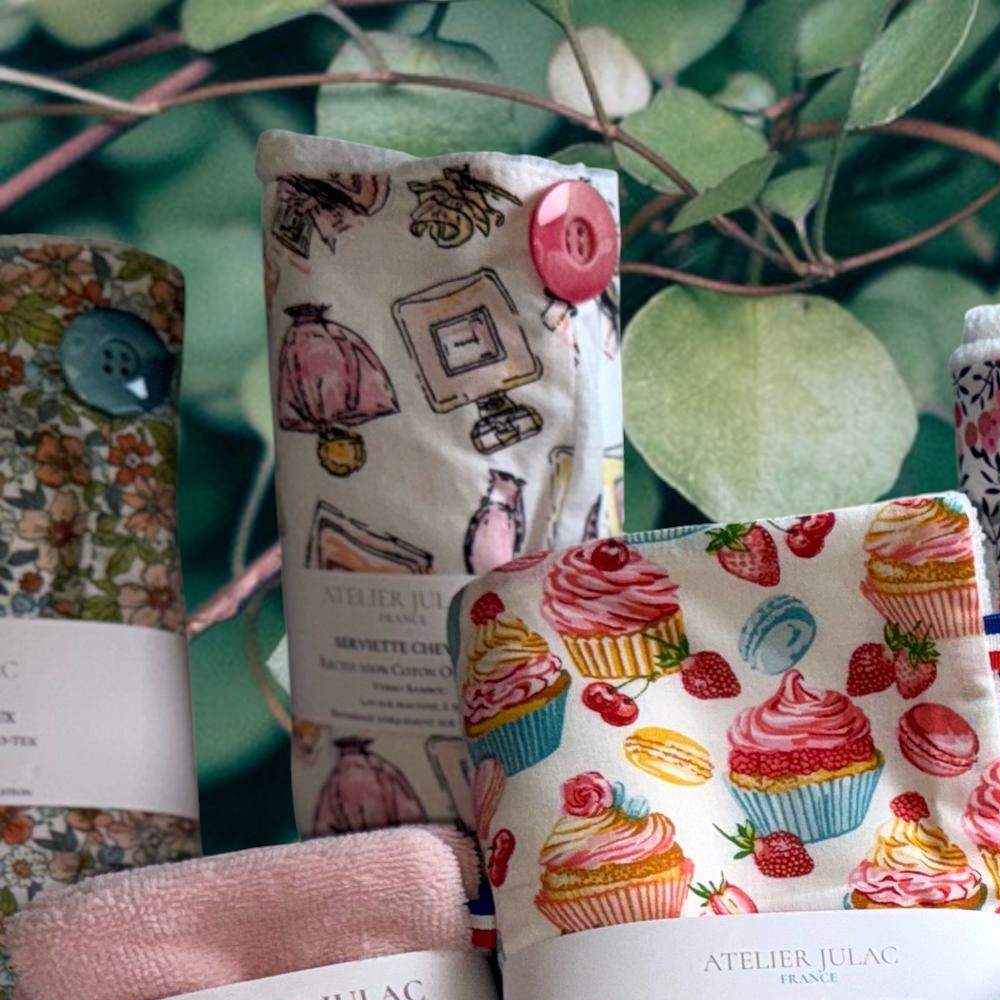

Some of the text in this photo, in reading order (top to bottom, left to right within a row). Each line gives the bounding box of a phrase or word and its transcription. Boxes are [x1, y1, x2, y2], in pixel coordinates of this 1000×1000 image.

[704, 946, 899, 972] ATELIER JULAC
[781, 971, 838, 985] FRANCE
